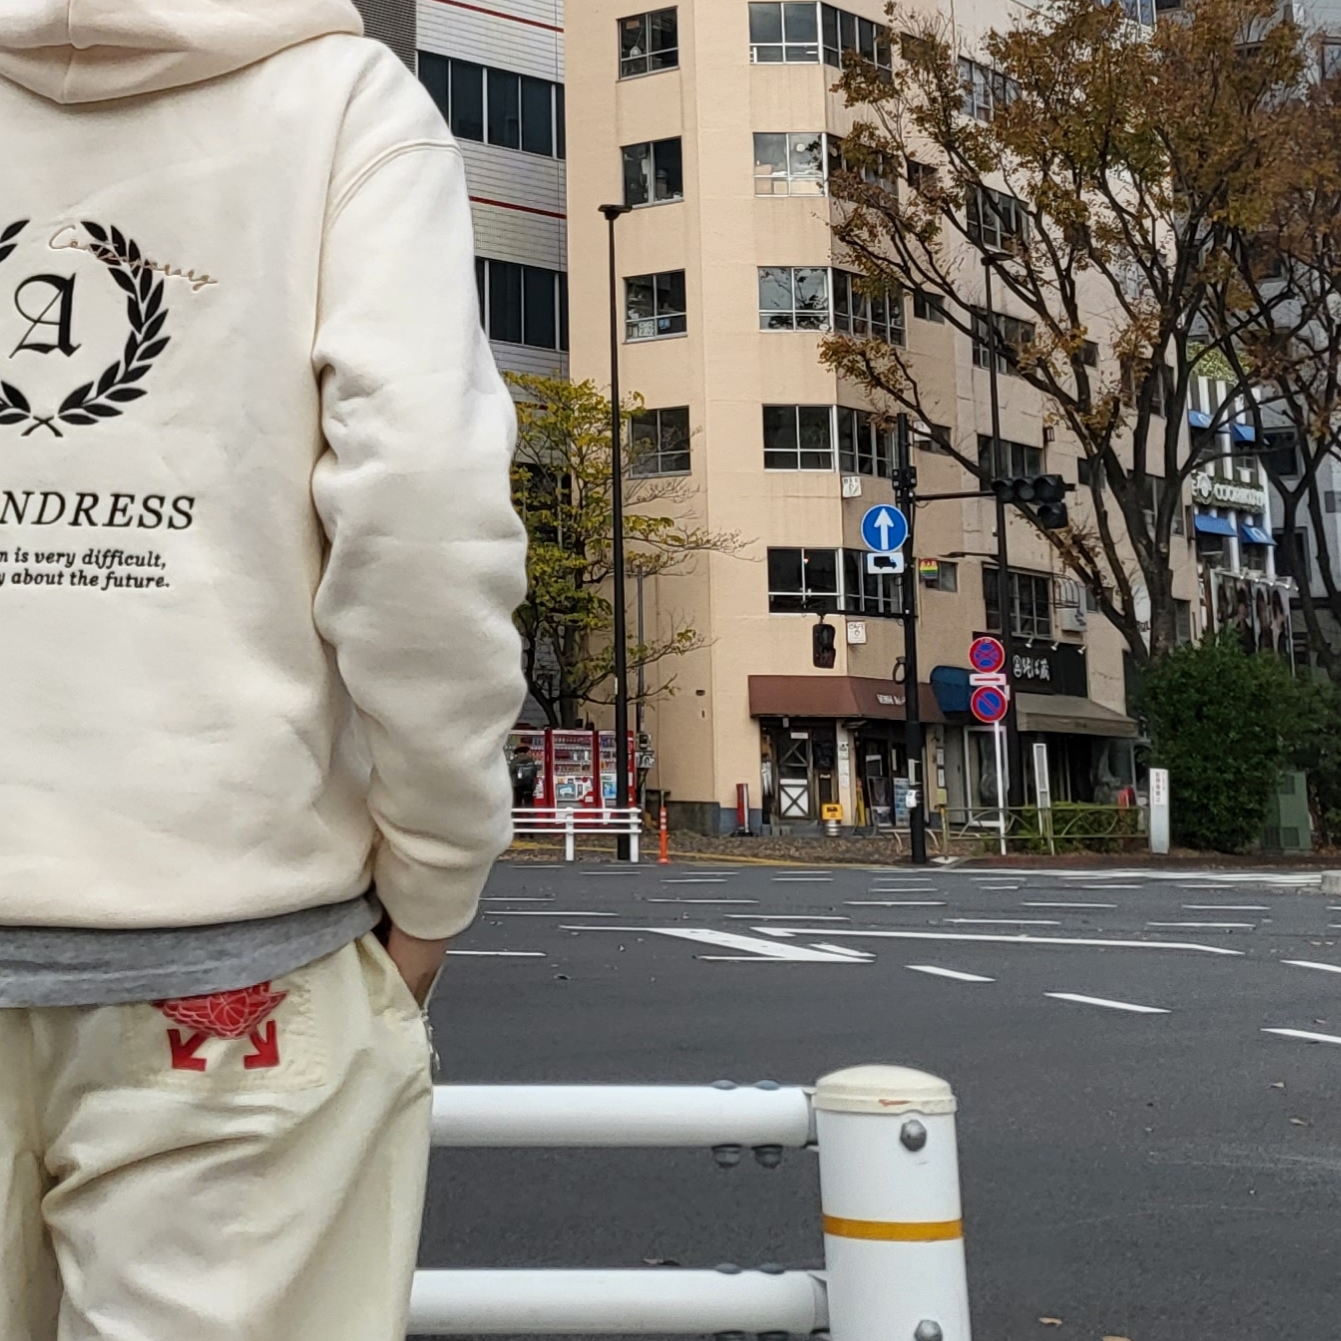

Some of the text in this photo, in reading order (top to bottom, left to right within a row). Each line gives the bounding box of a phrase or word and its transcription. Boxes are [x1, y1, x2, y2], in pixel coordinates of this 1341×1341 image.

[9, 272, 82, 359] A
[14, 547, 29, 563] is
[34, 552, 76, 569] very
[81, 548, 166, 570] difficult,
[11, 567, 65, 586] about
[69, 570, 99, 587] the
[100, 570, 170, 591] future.
